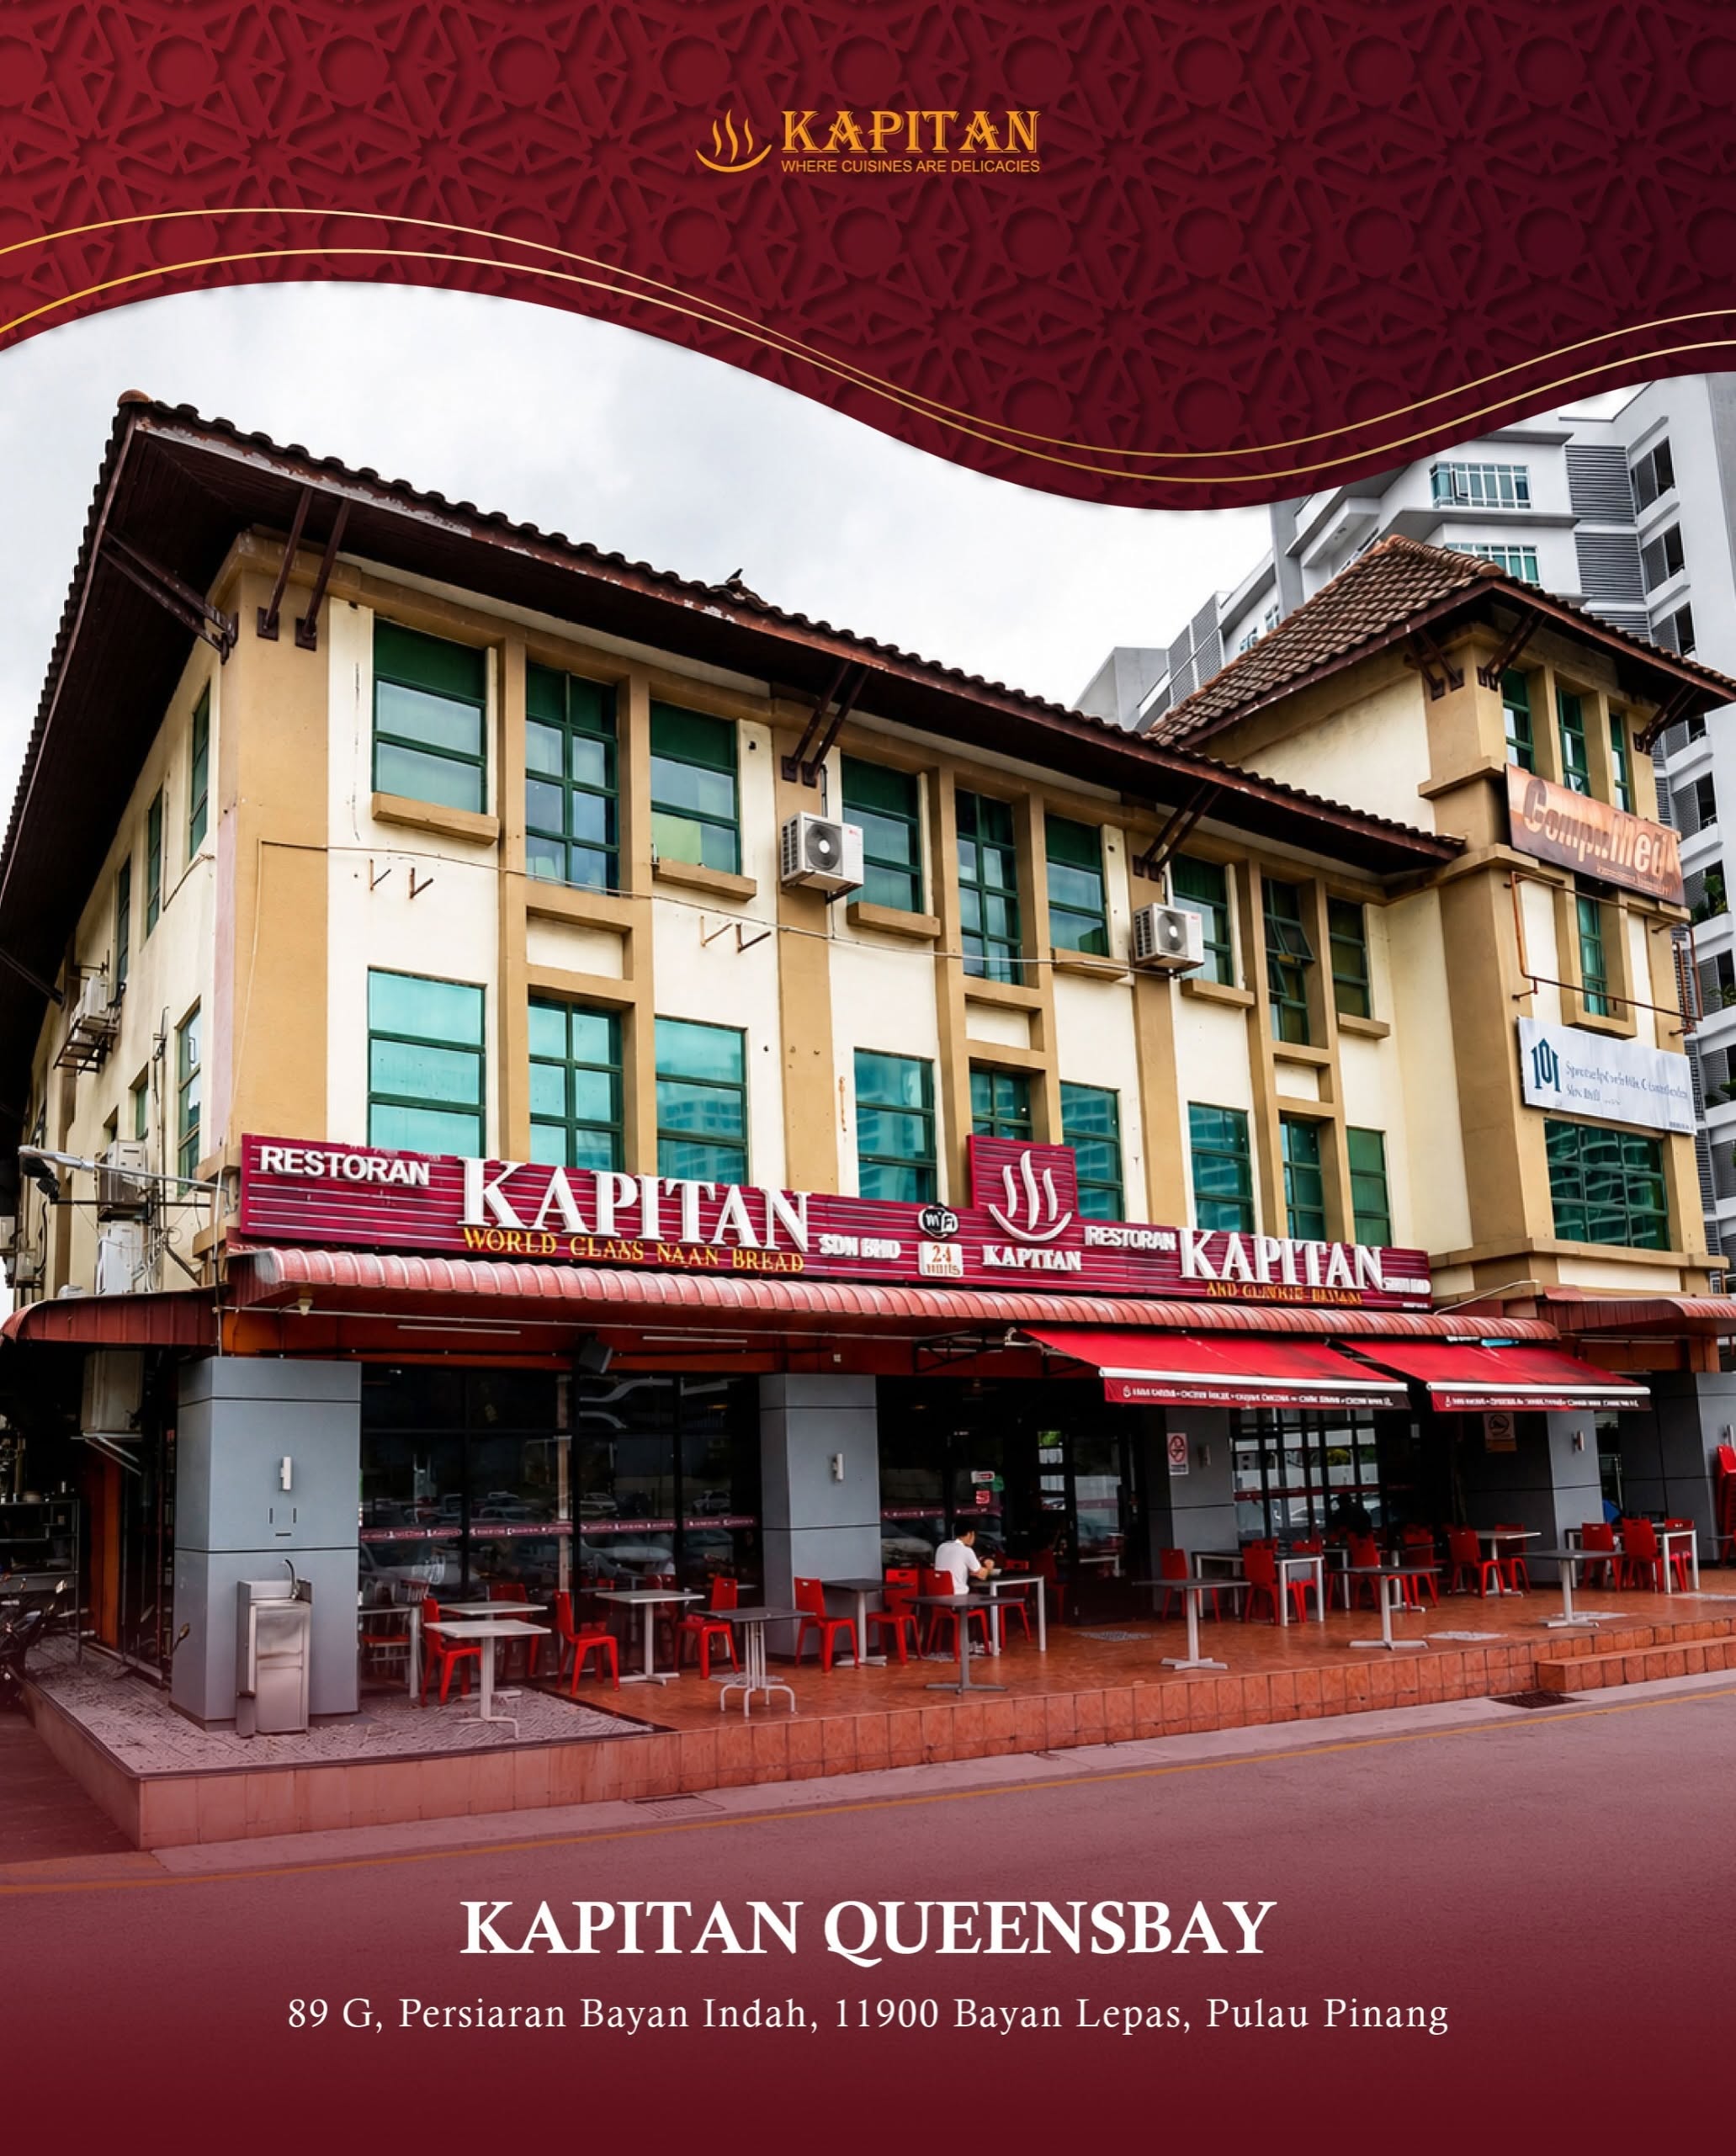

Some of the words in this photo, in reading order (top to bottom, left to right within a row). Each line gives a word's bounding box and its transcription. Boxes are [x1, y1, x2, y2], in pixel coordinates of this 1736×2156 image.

[260, 1145, 431, 1186] RESTORAN
[457, 1156, 812, 1252] KAPITAN
[464, 1227, 557, 1255] WORLD
[570, 1235, 645, 1261] CLASS
[656, 1243, 719, 1266] NAAN
[732, 1248, 804, 1273] BREAD
[982, 1245, 1082, 1272] KAPITAN
[1085, 1225, 1177, 1251] RESTORAN
[1177, 1227, 1384, 1290] KAPITAN
